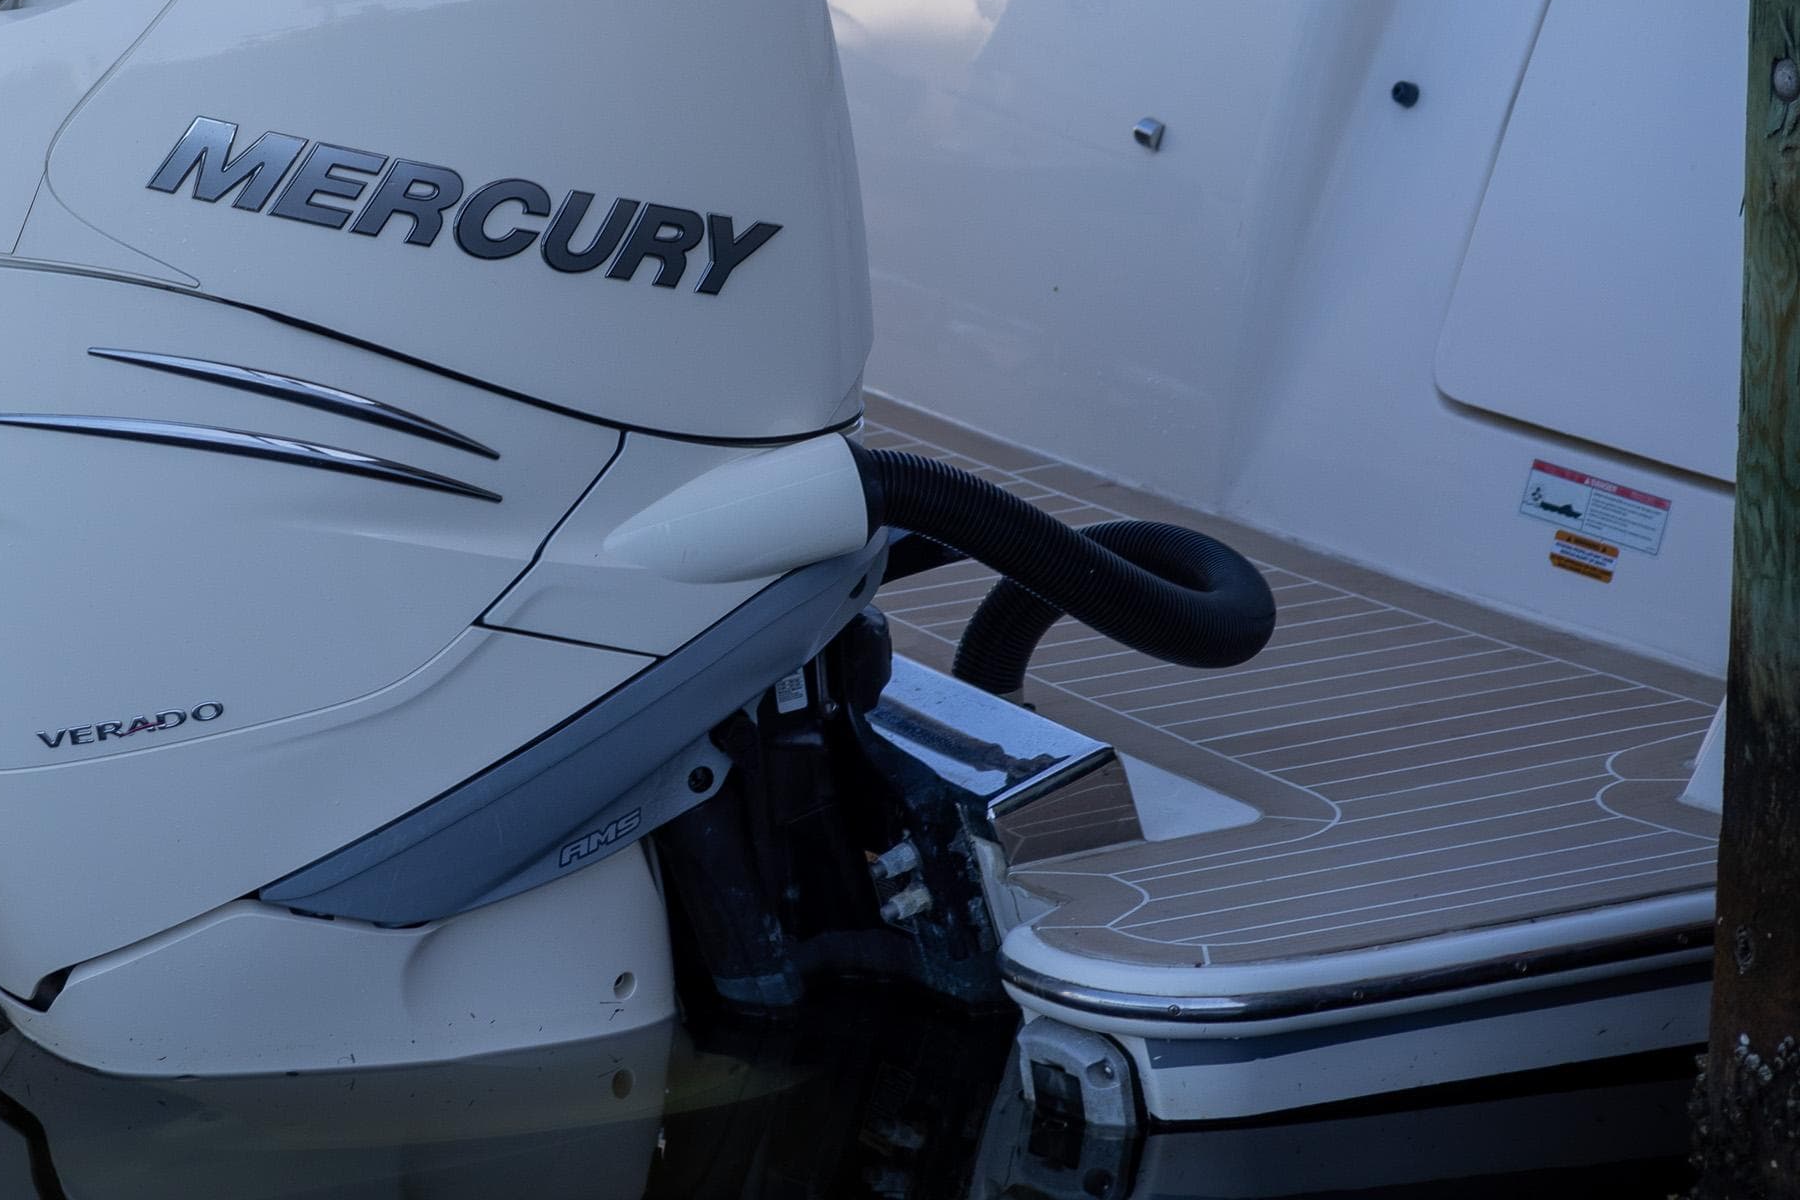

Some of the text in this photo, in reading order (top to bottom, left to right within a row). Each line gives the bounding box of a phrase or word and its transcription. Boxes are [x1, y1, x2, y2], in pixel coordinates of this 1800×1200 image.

[145, 115, 783, 295] MERCURY
[36, 700, 224, 748] VERADO
[559, 806, 642, 868] AMS
